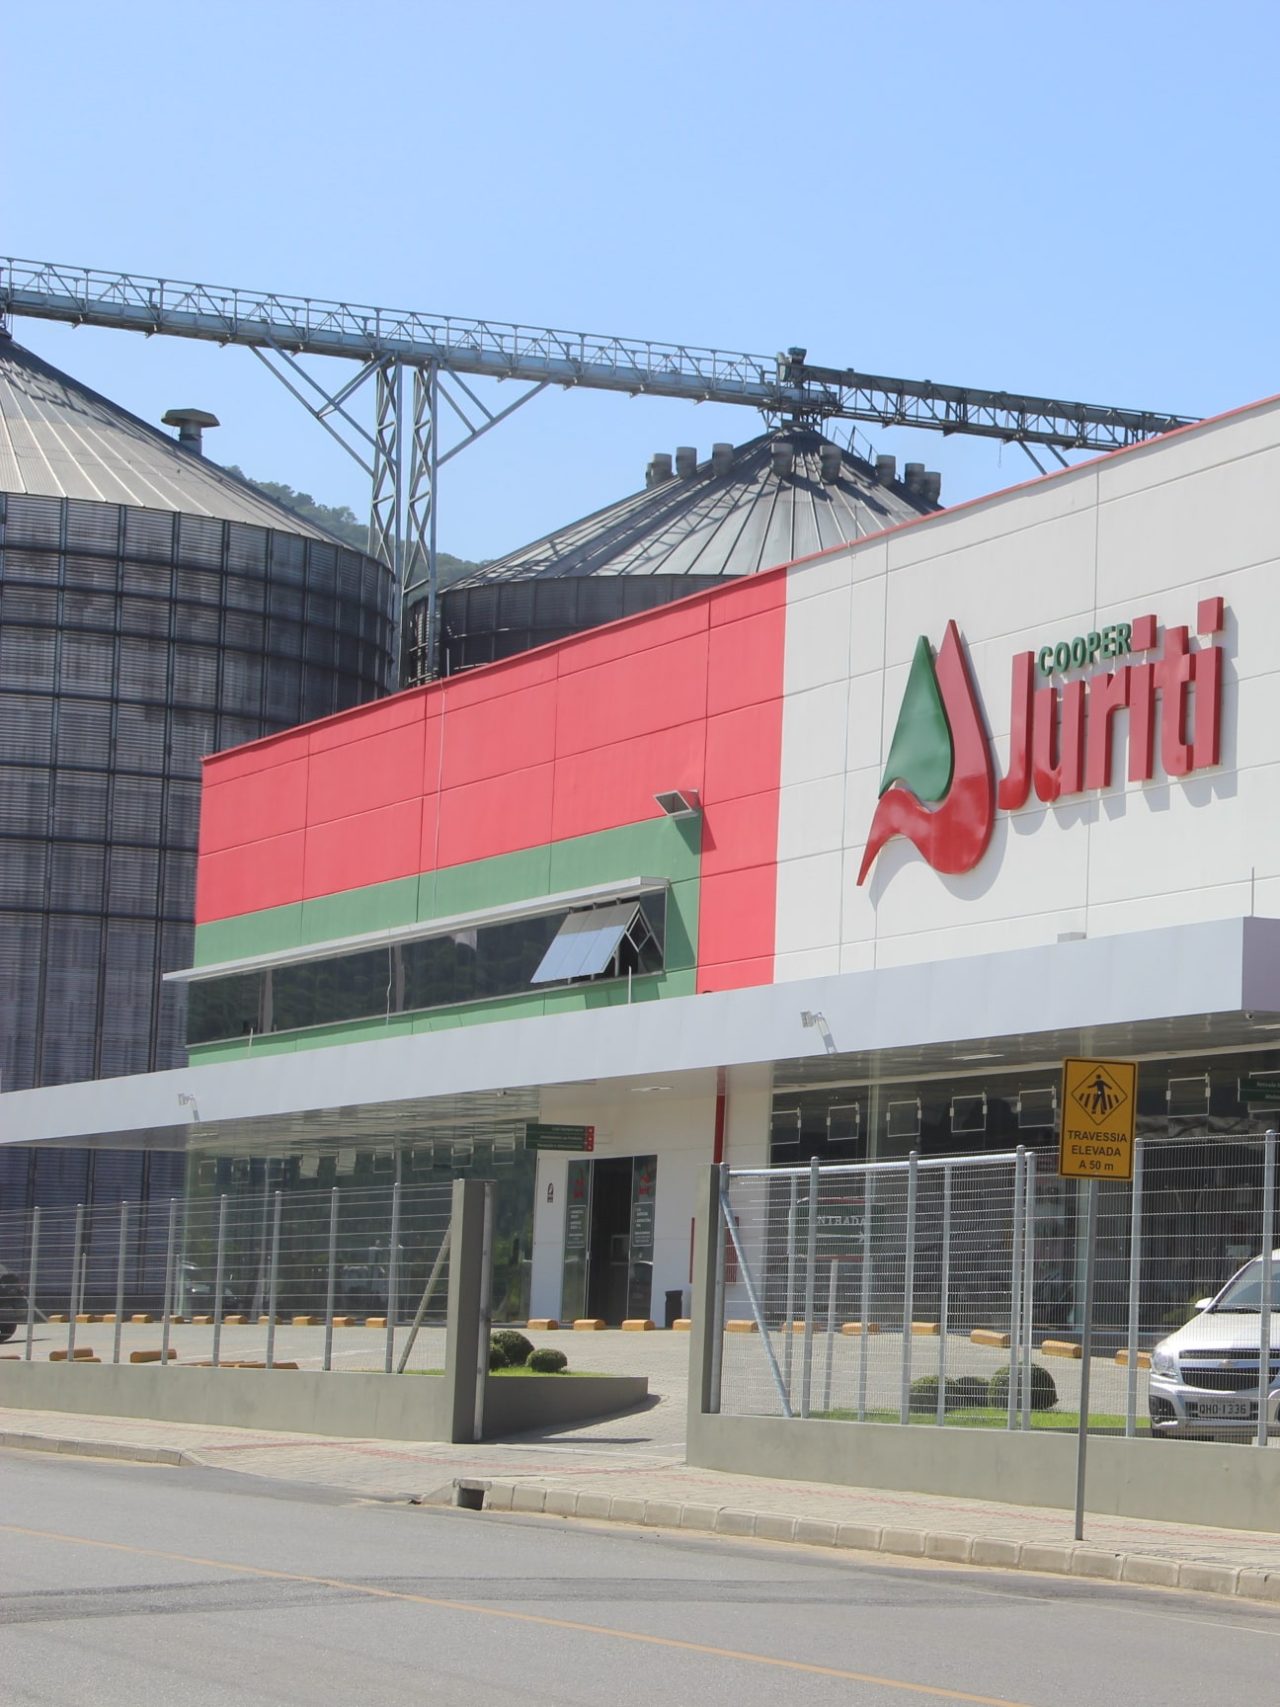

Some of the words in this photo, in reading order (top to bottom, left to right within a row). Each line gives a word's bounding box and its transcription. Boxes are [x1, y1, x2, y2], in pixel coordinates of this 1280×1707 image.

[1038, 623, 1132, 677] COOPER
[998, 597, 1224, 810] Juriti
[1068, 1130, 1128, 1142] TRAVESSIA
[1071, 1145, 1121, 1157] ELEVADA
[1079, 1160, 1087, 1169] A
[1089, 1160, 1101, 1170] 50
[814, 1215, 868, 1225] NTRADA
